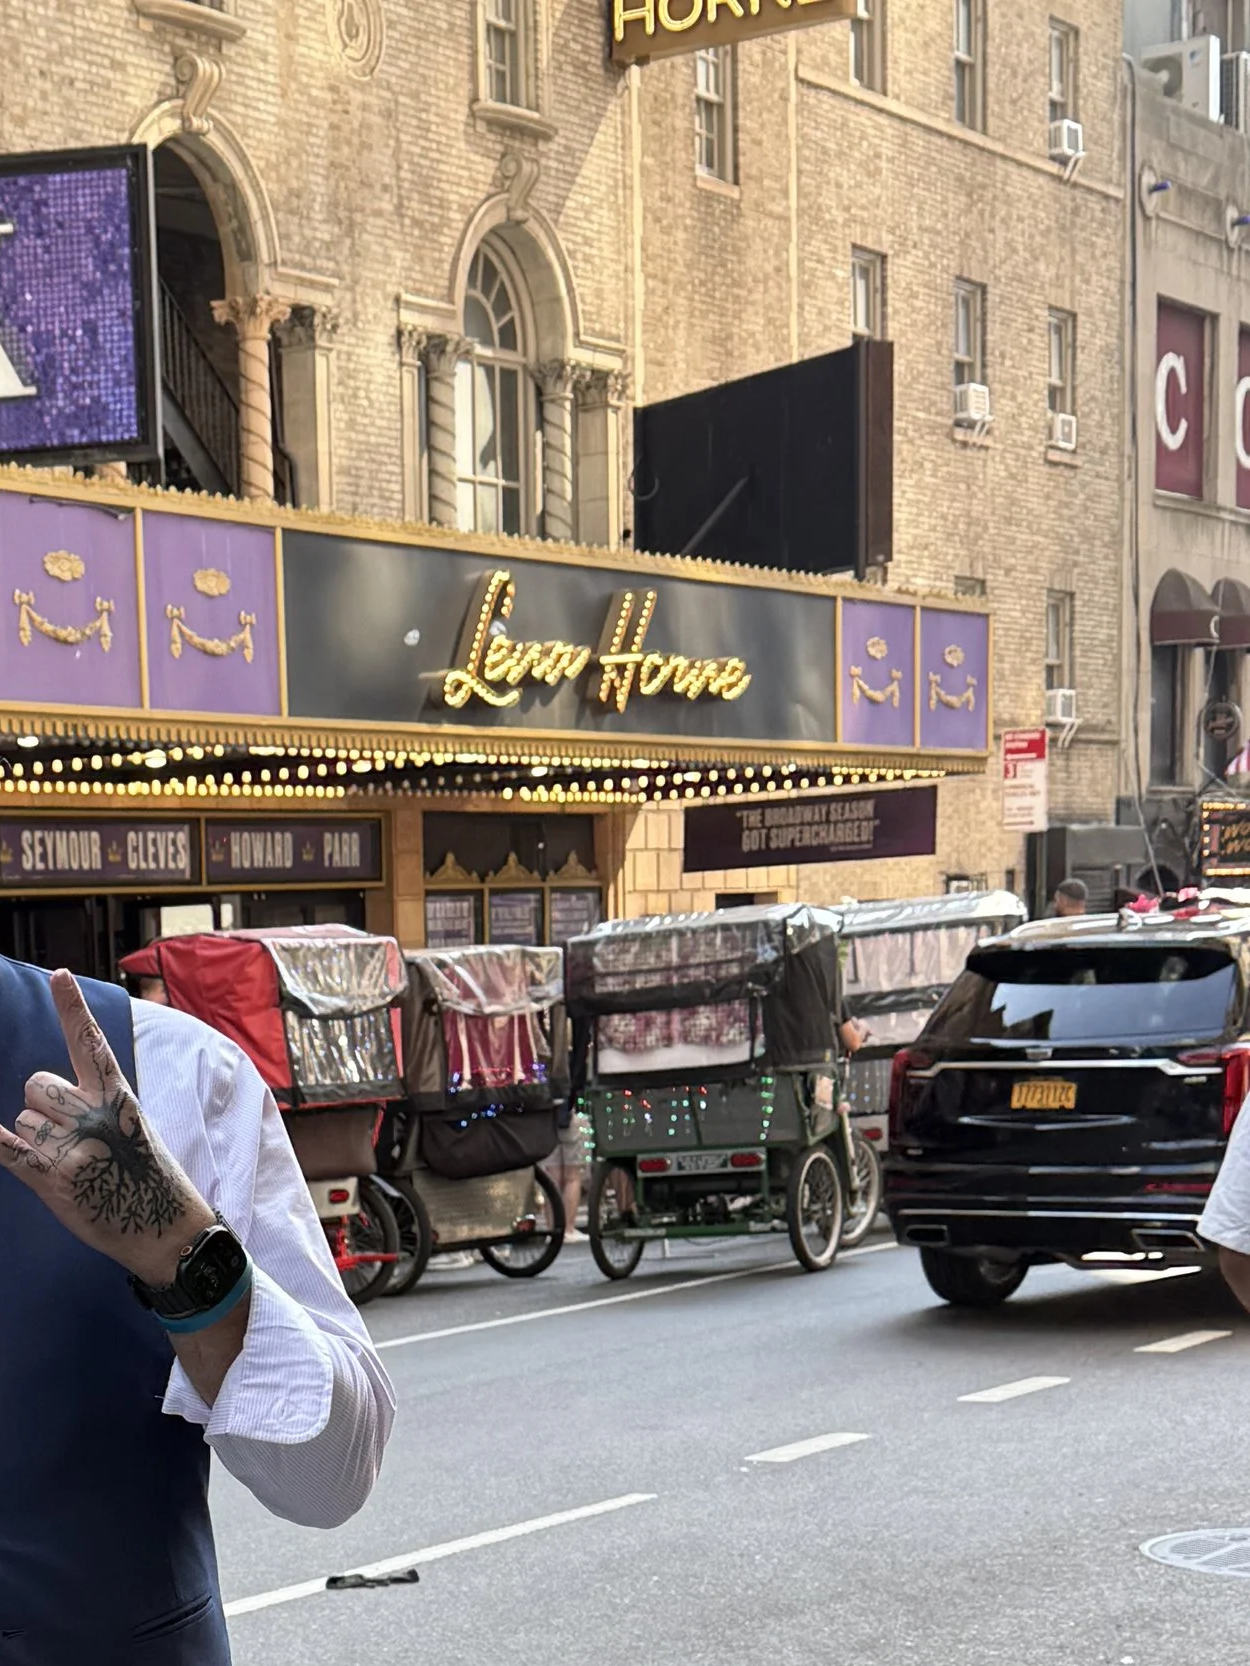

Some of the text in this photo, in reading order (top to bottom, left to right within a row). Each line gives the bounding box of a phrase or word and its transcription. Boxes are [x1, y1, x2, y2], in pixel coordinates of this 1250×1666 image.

[21, 830, 187, 870] SEYMOUR CLEVES
[230, 832, 360, 869] HOWARD PARR
